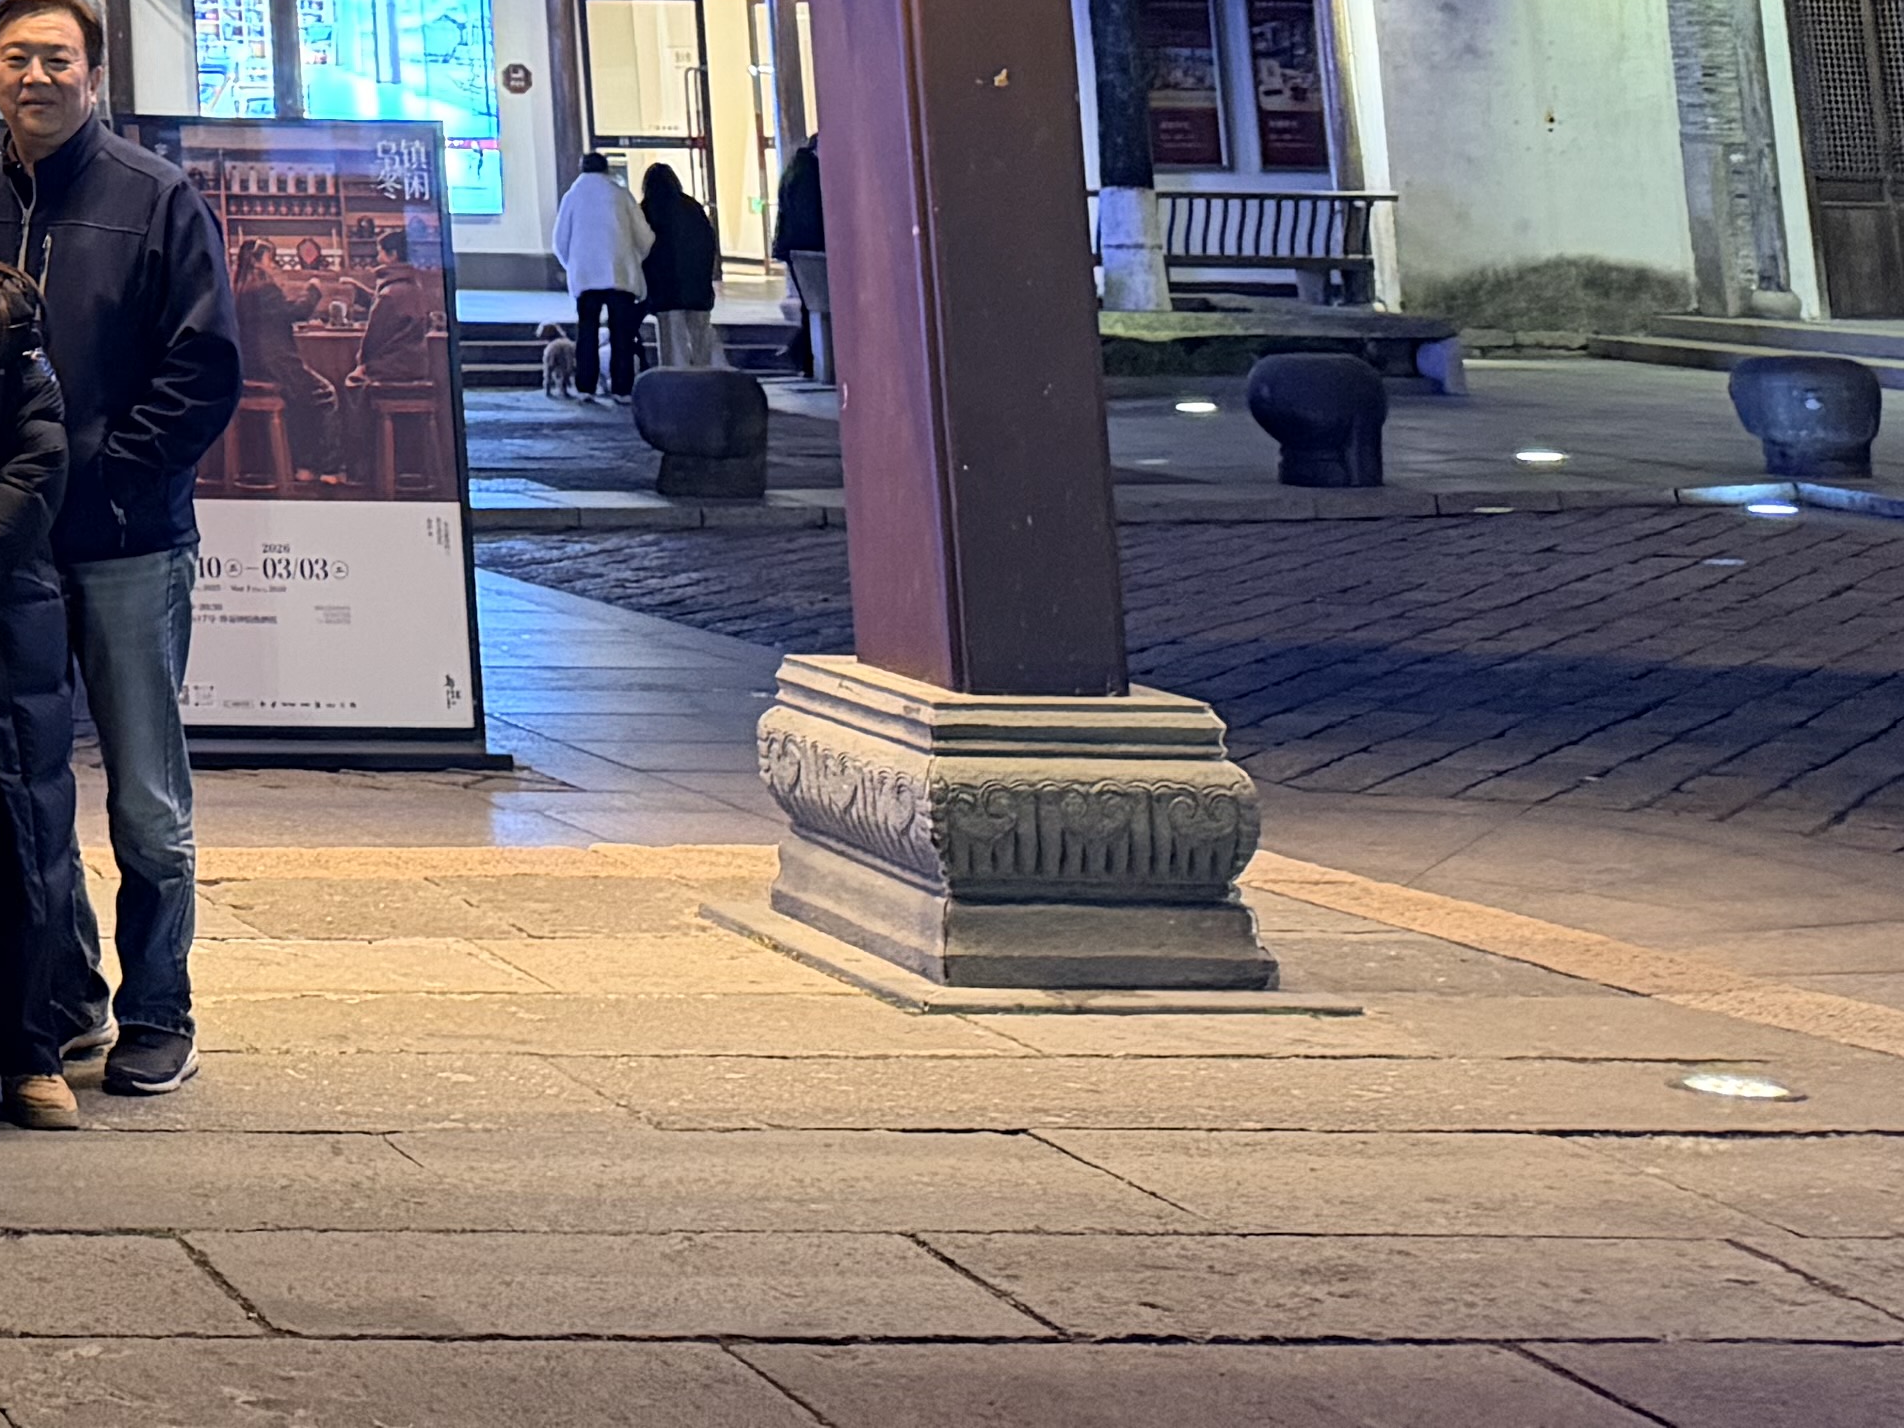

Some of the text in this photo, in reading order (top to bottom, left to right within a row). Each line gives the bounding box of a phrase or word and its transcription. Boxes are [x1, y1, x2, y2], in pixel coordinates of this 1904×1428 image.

[375, 139, 427, 170] 乌镇
[261, 543, 291, 554] 2026
[262, 556, 329, 580] 03/03
